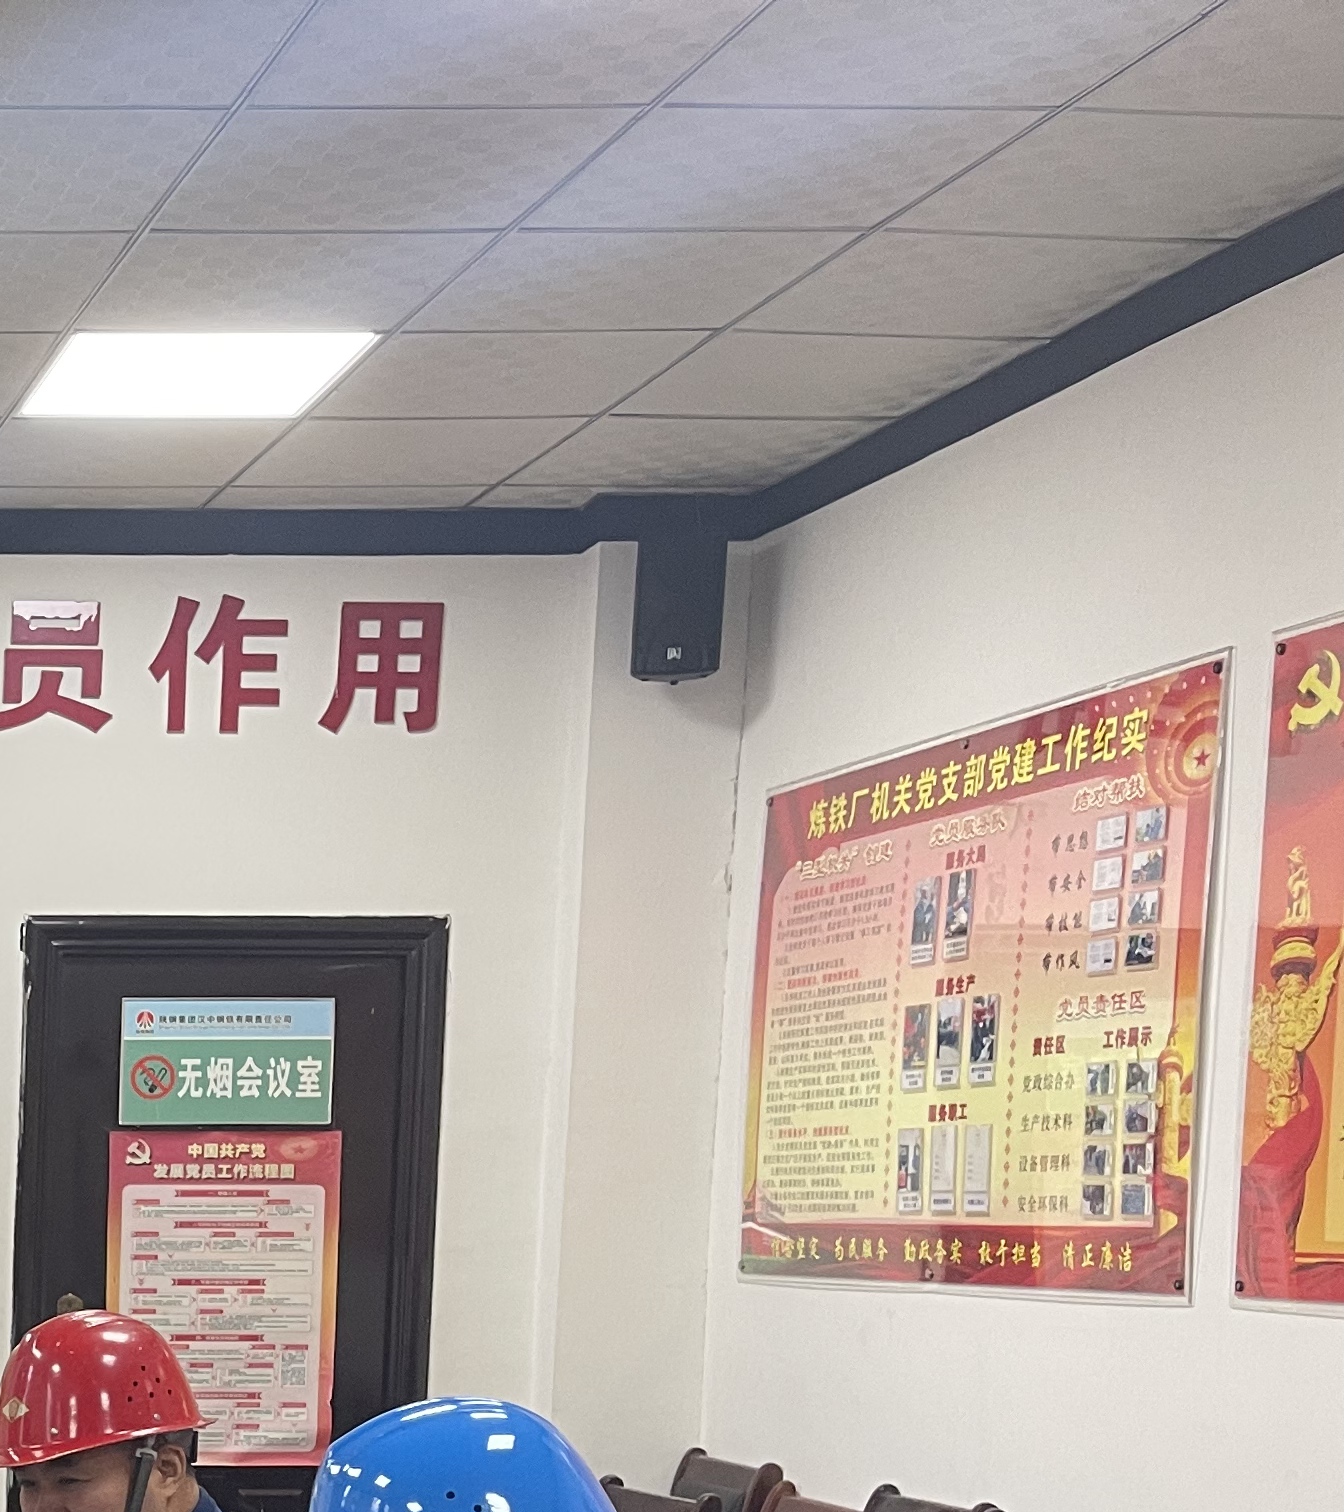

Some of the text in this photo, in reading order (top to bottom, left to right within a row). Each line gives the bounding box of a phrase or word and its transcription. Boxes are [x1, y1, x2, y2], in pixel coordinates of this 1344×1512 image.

[807, 707, 1150, 840] 炼铁厂机关党支部党建工作纪实
[935, 974, 976, 997] 服务生产
[1057, 990, 1146, 1021] 党员责任区
[1032, 1026, 1152, 1057] 责任区 工作展示
[177, 1056, 322, 1099] 无烟会议室
[1021, 1113, 1073, 1133] 生产技术科
[187, 1143, 266, 1158] 中国共产党
[1018, 1154, 1071, 1173] 设备管理科
[153, 1163, 296, 1179] 发展党员工作流程图
[978, 1239, 1041, 1268] 敢于担当
[1062, 1240, 1132, 1272] 清正廉洁
